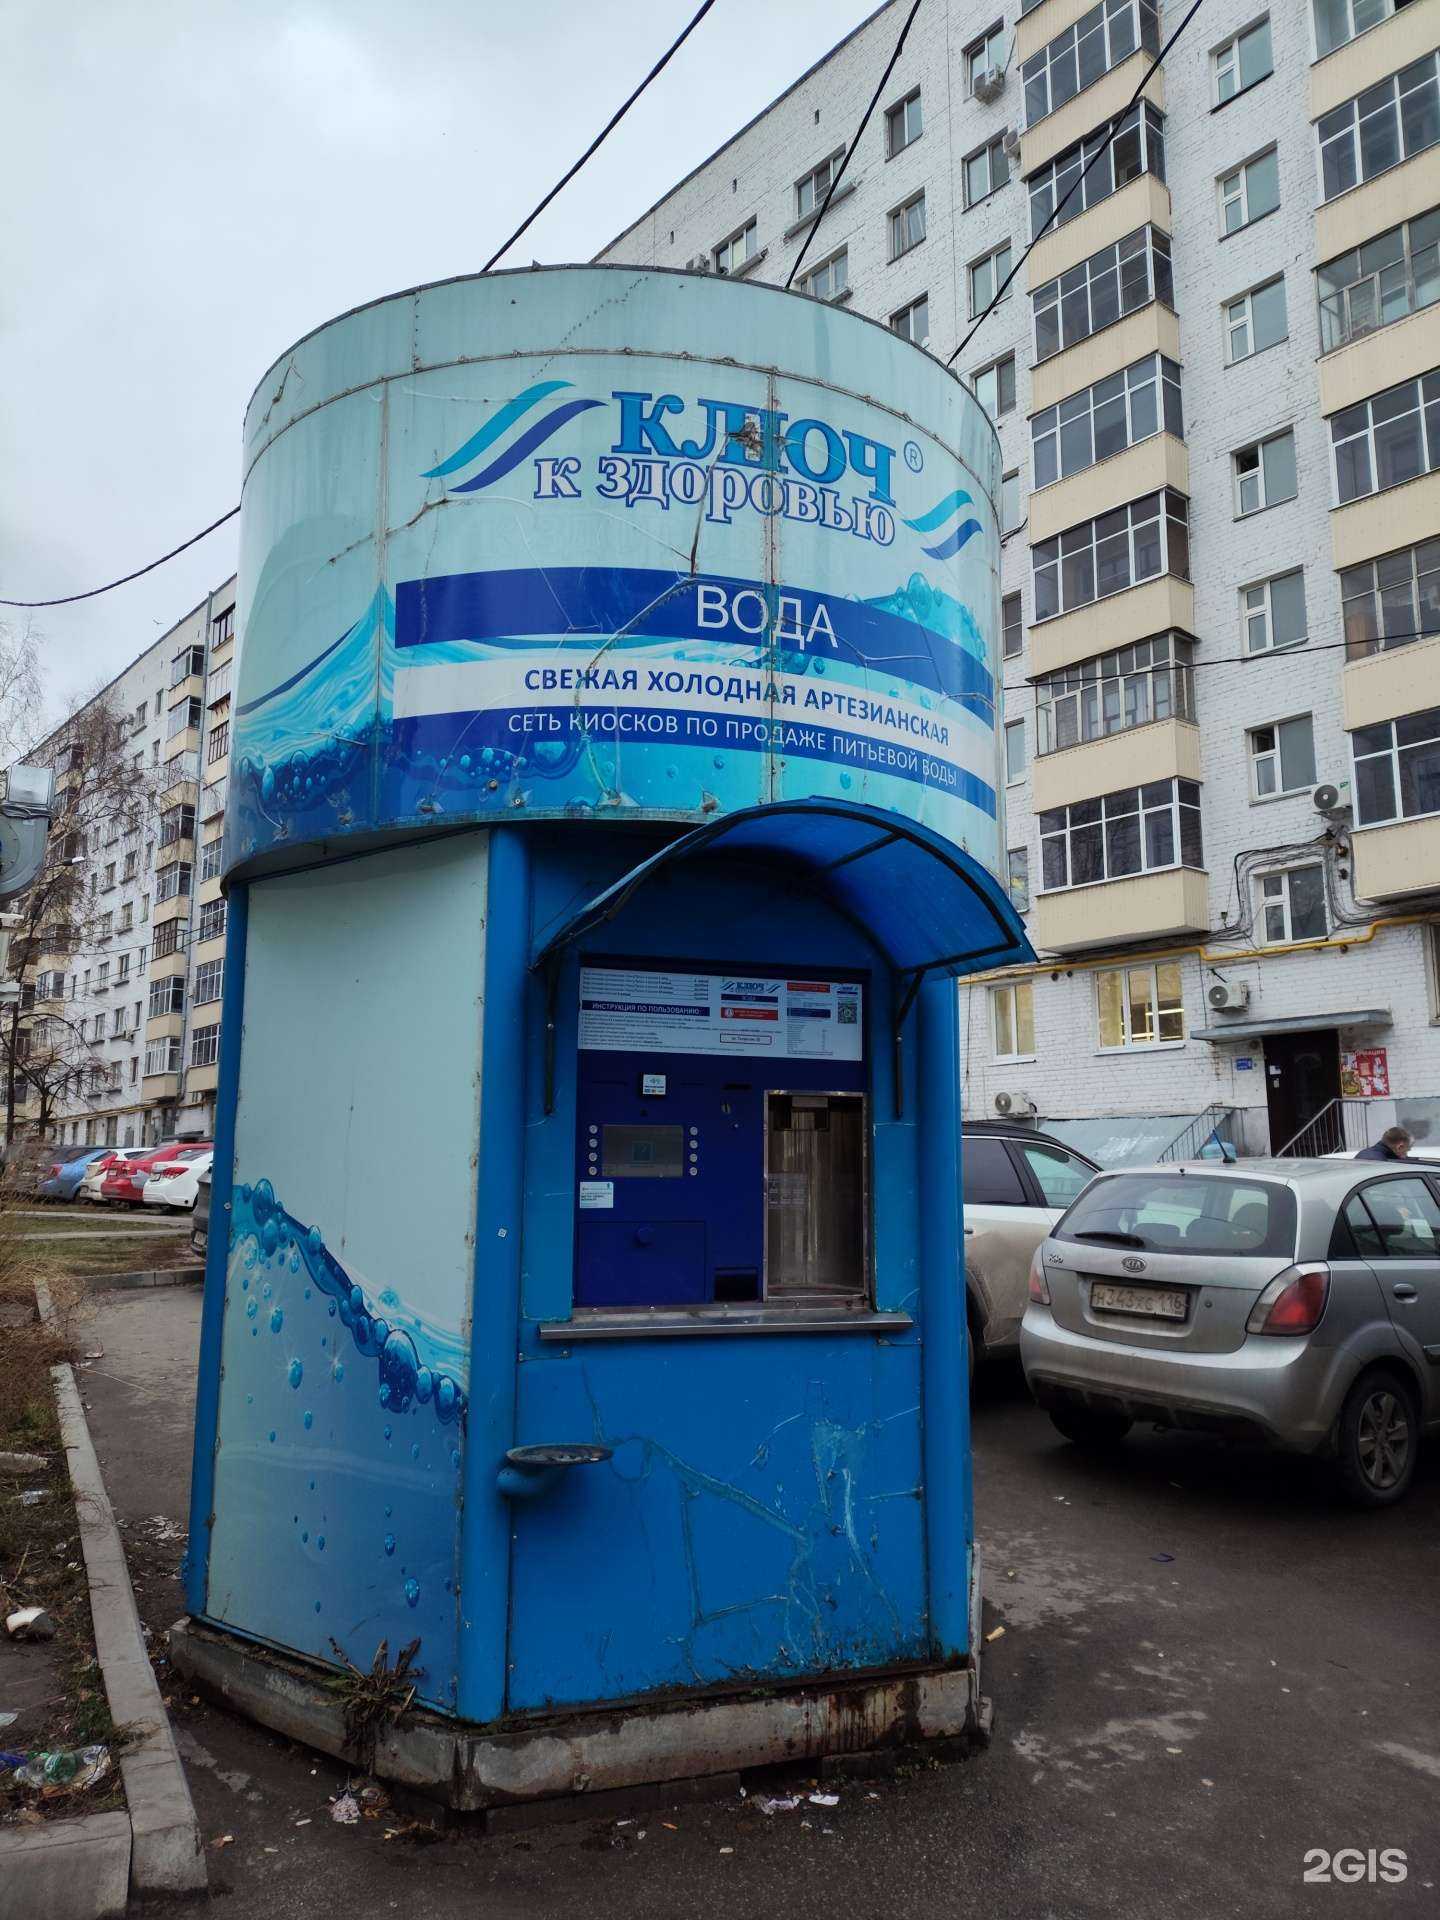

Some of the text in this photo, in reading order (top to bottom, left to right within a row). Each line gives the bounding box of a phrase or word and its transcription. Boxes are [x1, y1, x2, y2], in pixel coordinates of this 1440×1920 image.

[611, 391, 896, 507] КЛЮЧ
[697, 585, 838, 650] ВОДА
[524, 669, 949, 747] СВЕЖАЯ ХОЛОДНАЯ АРТЕЗИАНСКАЯ
[508, 713, 958, 787] СЕТЬ КИОСКОВ ПО ПРОДАЖЕ ПИТЬЕВОЙ ВОДЫ
[592, 1002, 637, 1012] ИНСТРУКЦИЯ
[648, 1005, 700, 1015] ПОЛЬЗОВАНИЮ
